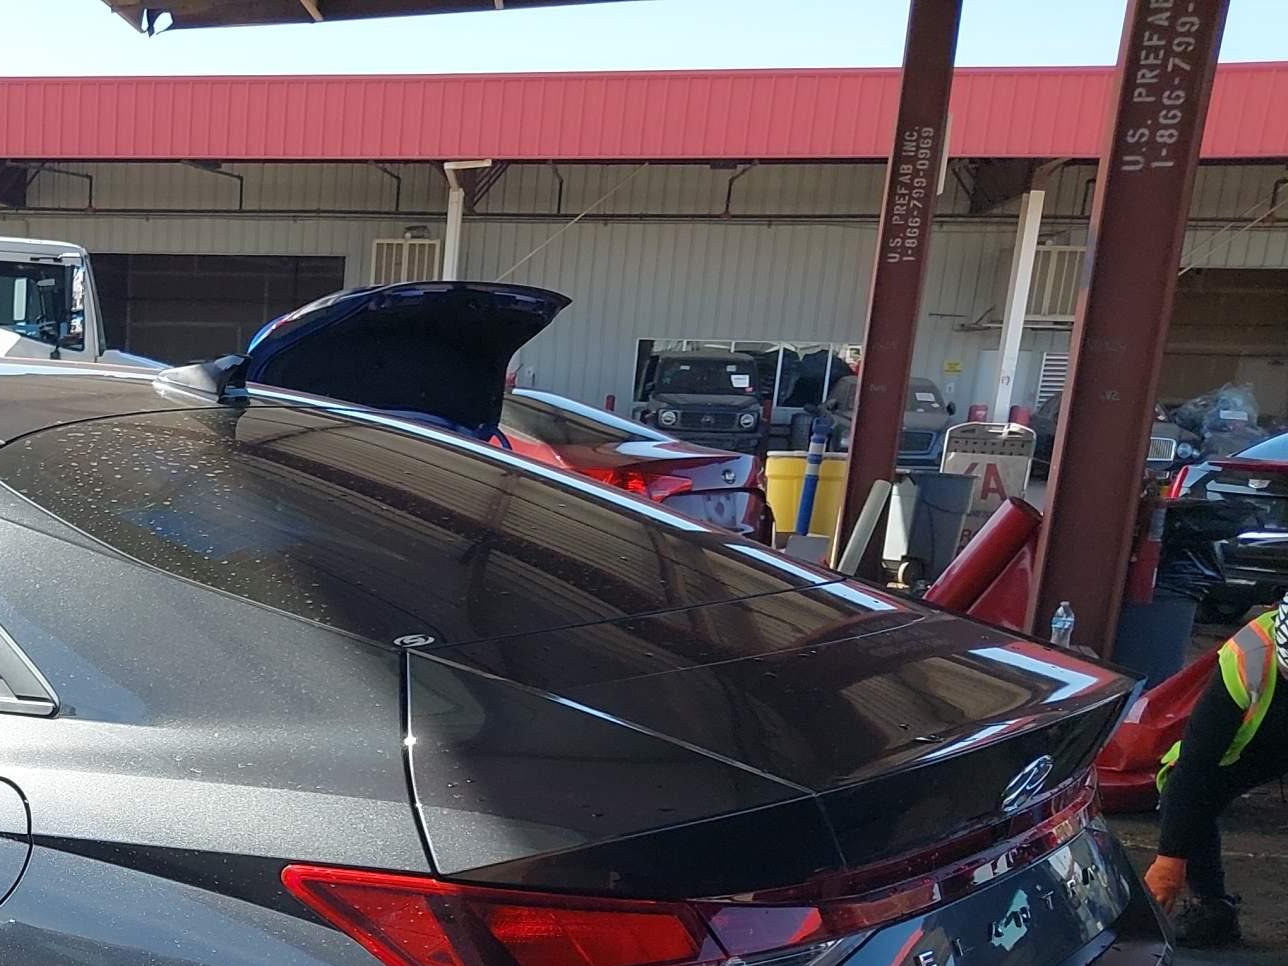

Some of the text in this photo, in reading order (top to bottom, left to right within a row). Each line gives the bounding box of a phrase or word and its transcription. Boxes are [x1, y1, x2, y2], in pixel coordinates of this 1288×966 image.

[887, 126, 920, 263] U.S. PREFAB INC.
[902, 126, 935, 262] 1-866-799-0969
[1121, 119, 1152, 171] U.S.
